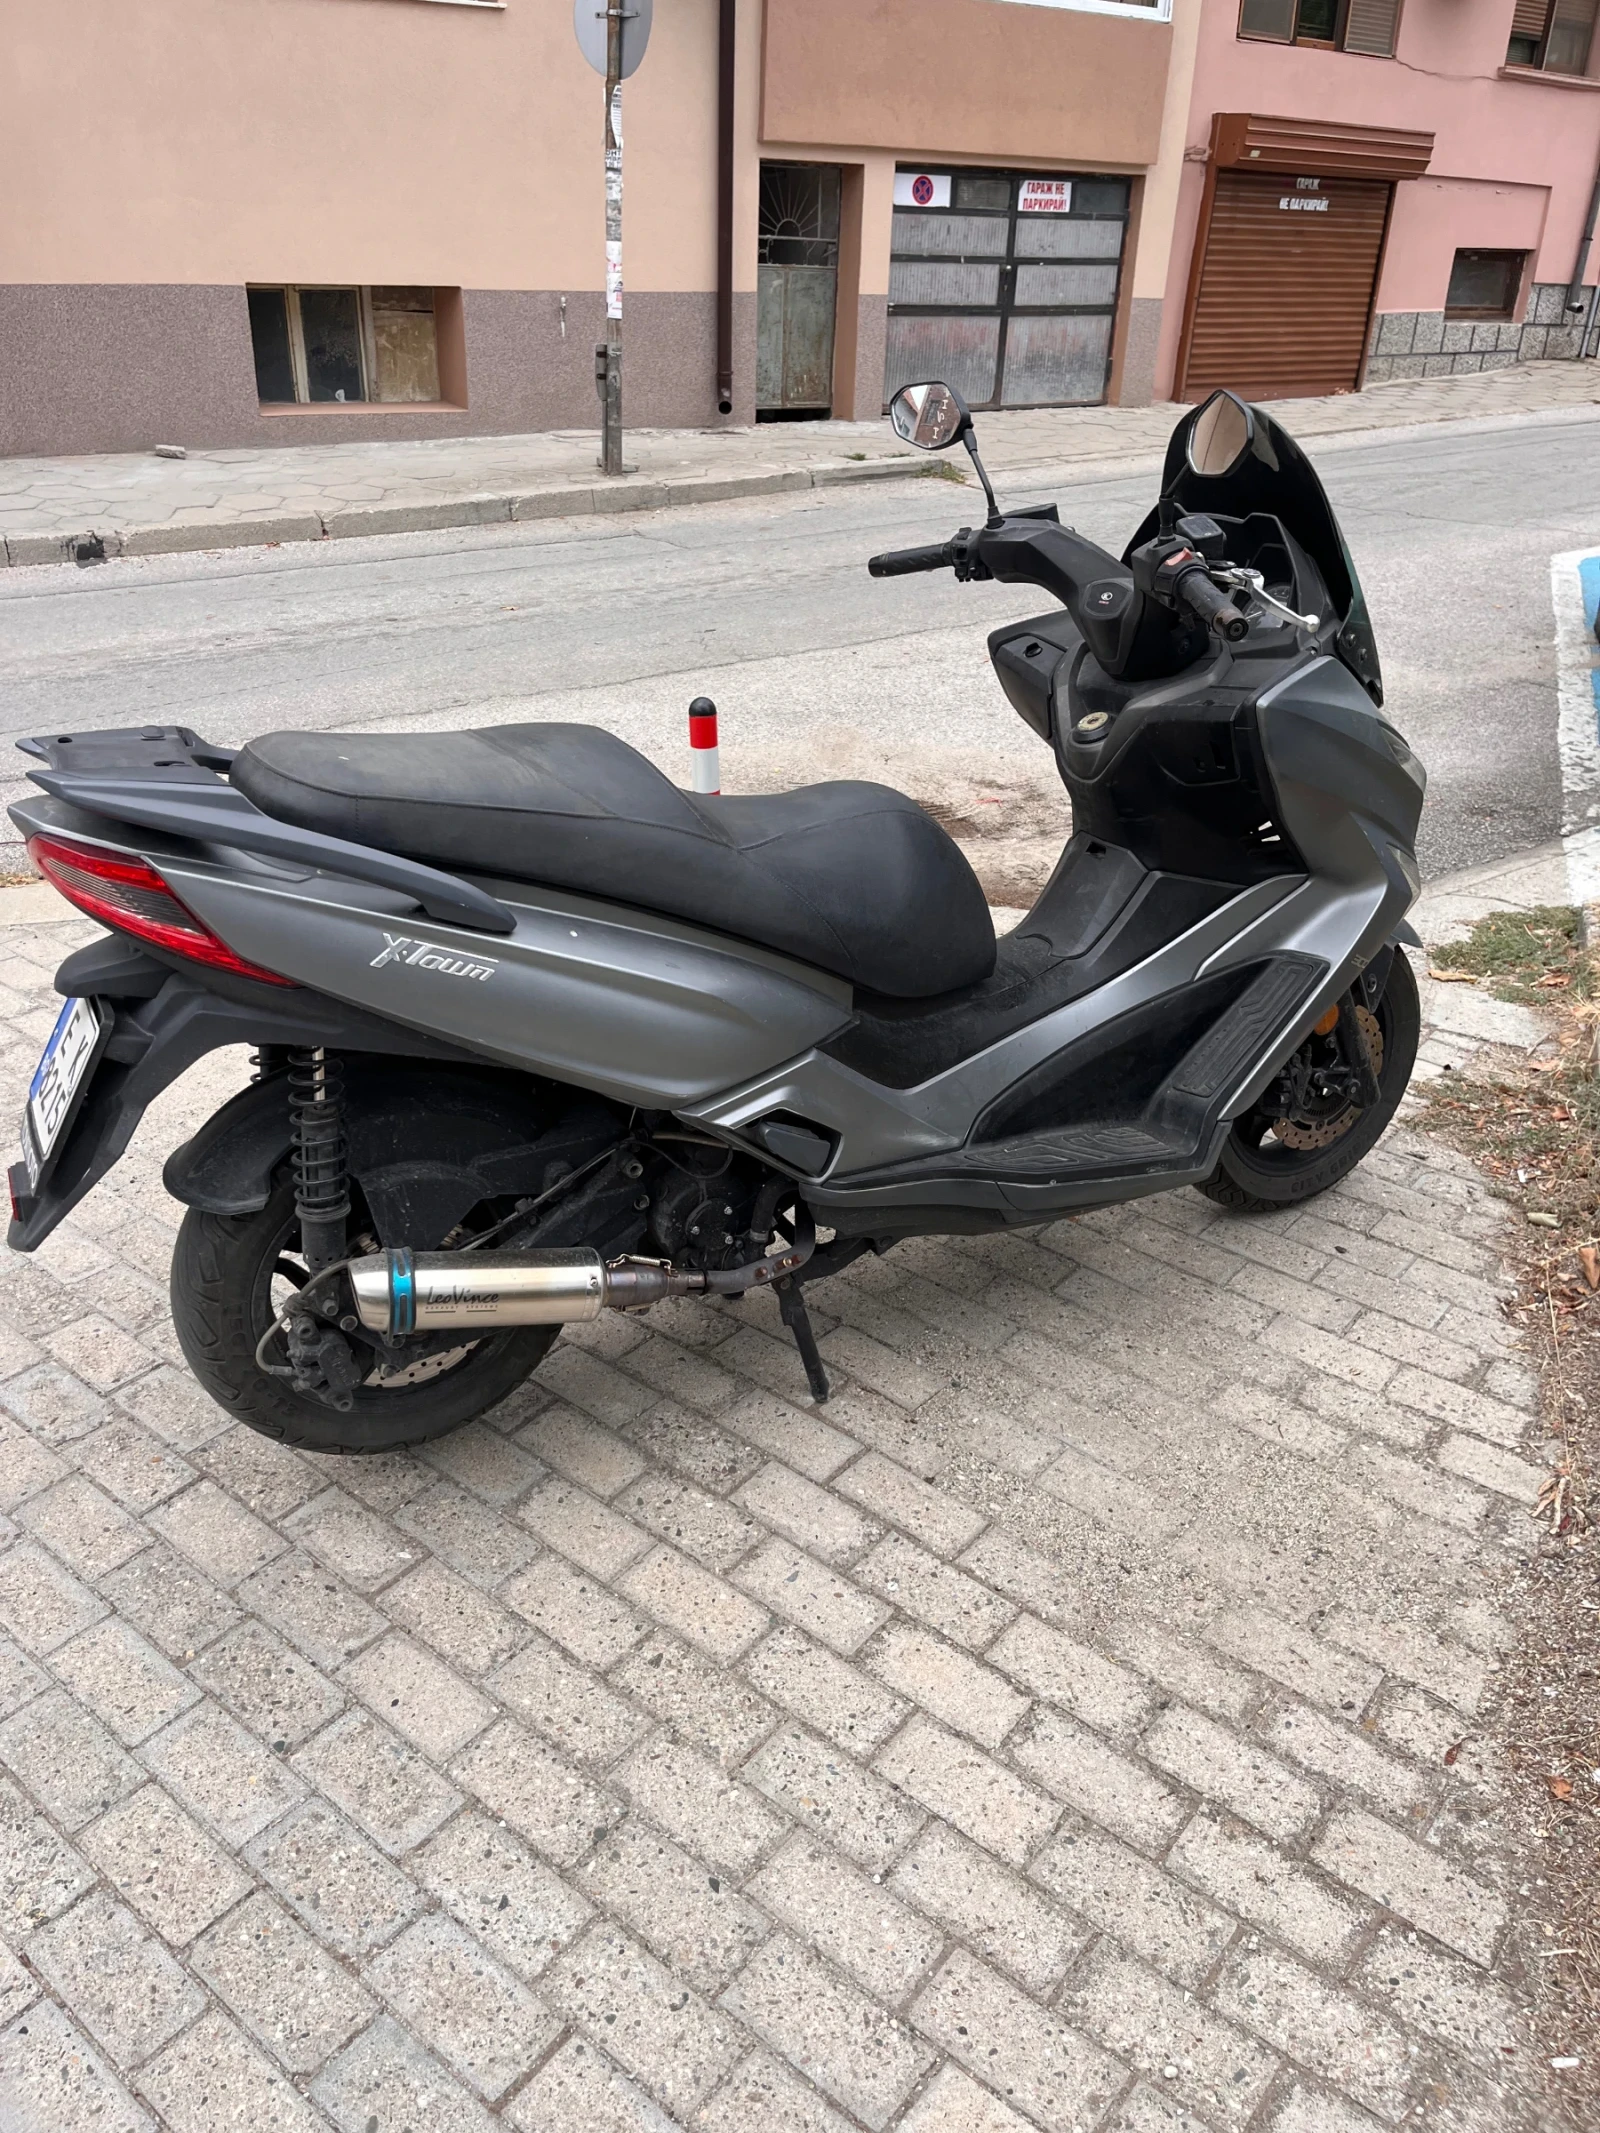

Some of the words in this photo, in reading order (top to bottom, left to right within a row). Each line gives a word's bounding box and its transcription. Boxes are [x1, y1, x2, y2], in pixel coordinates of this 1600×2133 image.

[1027, 182, 1053, 195] ГАРАЖ
[1055, 183, 1065, 195] НЕ
[1023, 197, 1067, 211] ПАРКИРАЙ!
[1279, 197, 1290, 210] НЕ
[61, 1009, 81, 1058] E
[68, 1034, 89, 1085] K
[38, 1056, 67, 1136] 8215
[426, 1284, 500, 1305] LeoVince
